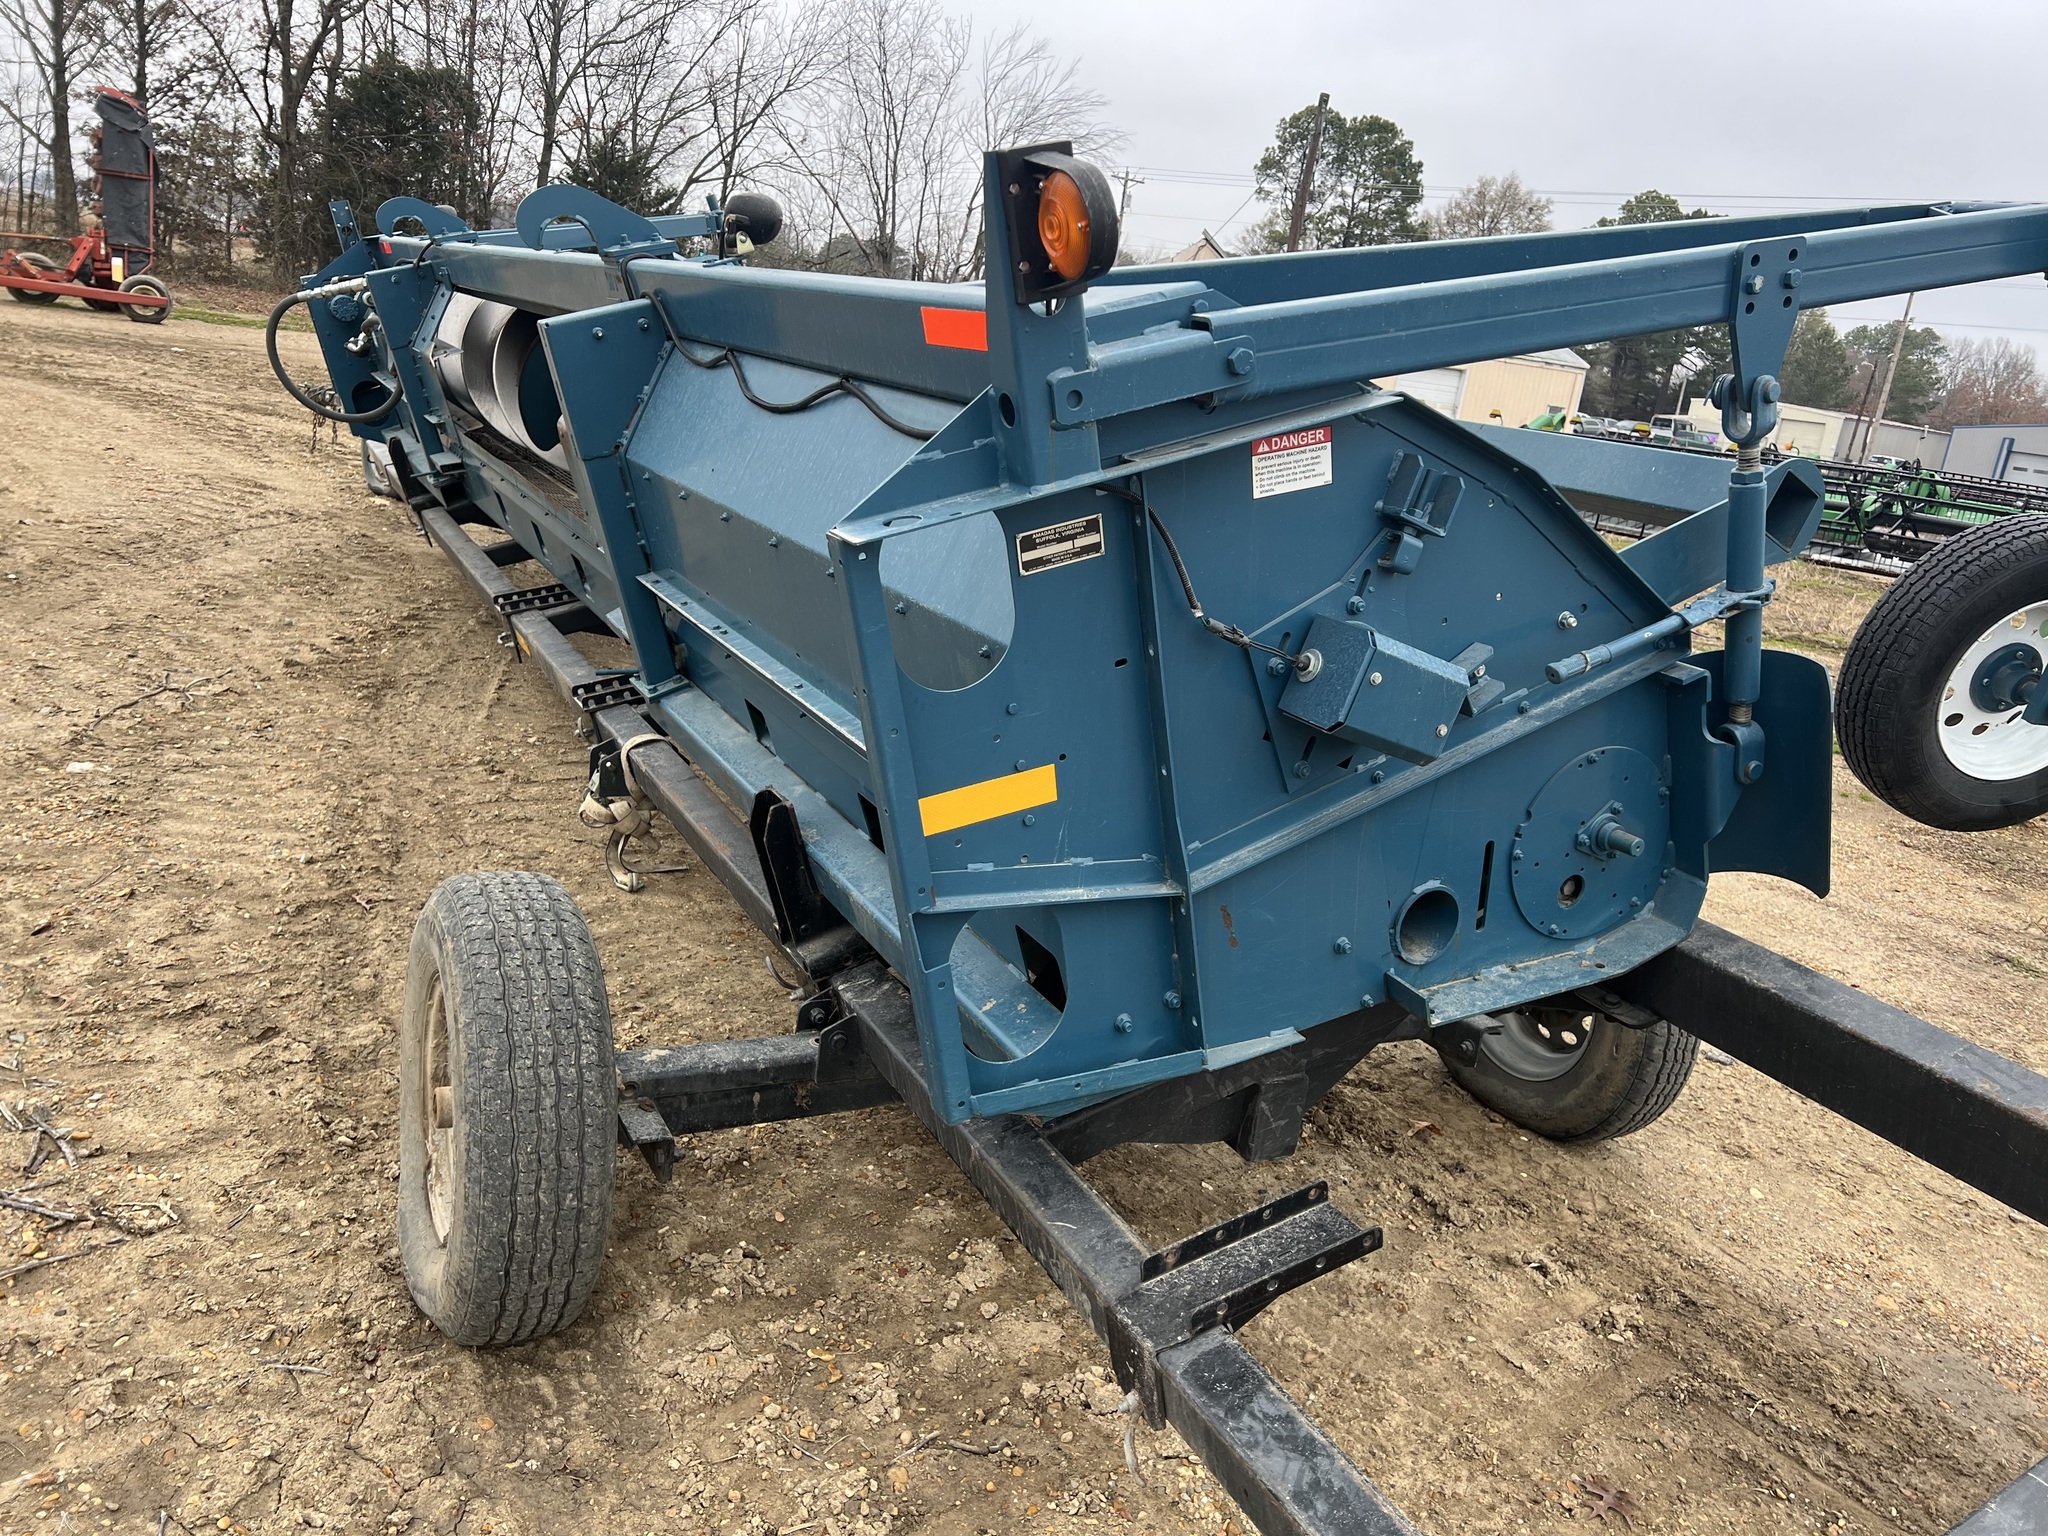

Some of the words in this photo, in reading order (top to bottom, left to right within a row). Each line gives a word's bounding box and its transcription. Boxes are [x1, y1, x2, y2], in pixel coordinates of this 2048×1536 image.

[1272, 429, 1324, 450] DANGER
[1257, 453, 1285, 463] OPERATING
[1286, 449, 1307, 458] MACHINE
[1308, 445, 1327, 453] HAZARD
[1035, 533, 1061, 544] SUFFOLK,
[1062, 527, 1084, 537] VIRGINIA
[1055, 521, 1087, 533] INDUSTRIES
